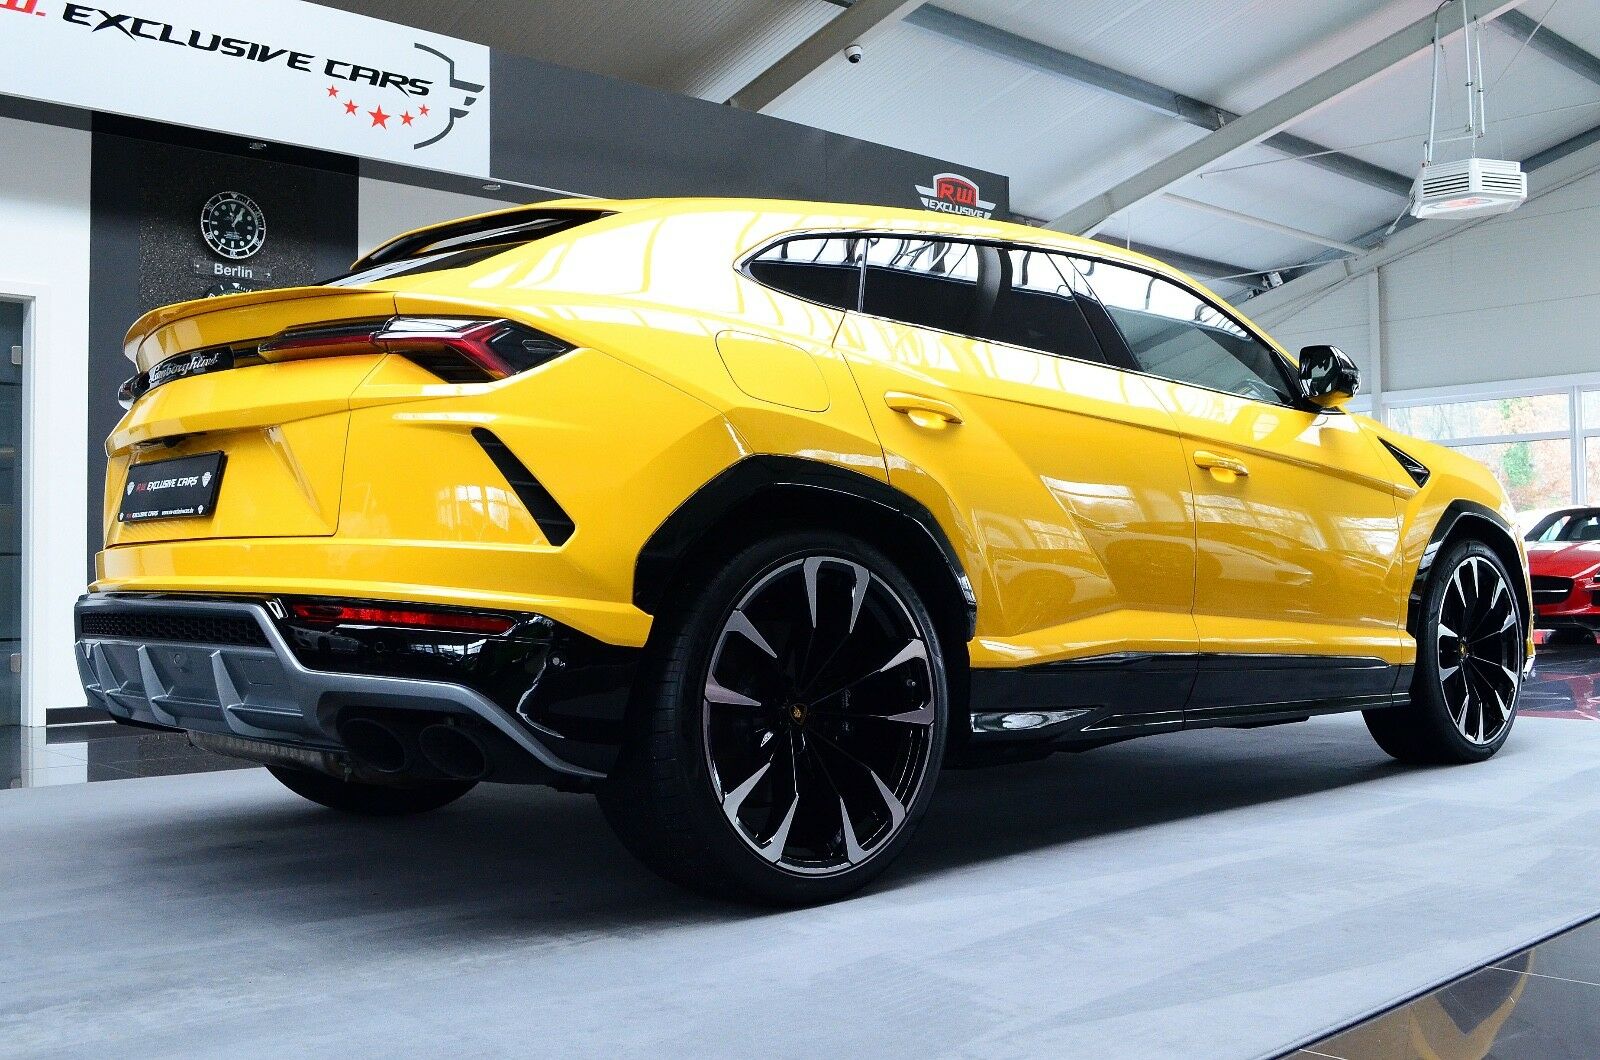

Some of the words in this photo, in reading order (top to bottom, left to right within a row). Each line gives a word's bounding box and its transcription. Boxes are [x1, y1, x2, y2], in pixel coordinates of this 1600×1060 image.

[62, 2, 316, 73] EXCLUSIVE
[323, 58, 434, 98] CARS
[940, 183, 973, 204] RW
[928, 199, 984, 218] EXCLUSIVE
[214, 263, 253, 278] Berlin
[147, 478, 177, 493] EXCLUSIVE
[177, 476, 199, 488] CARS
